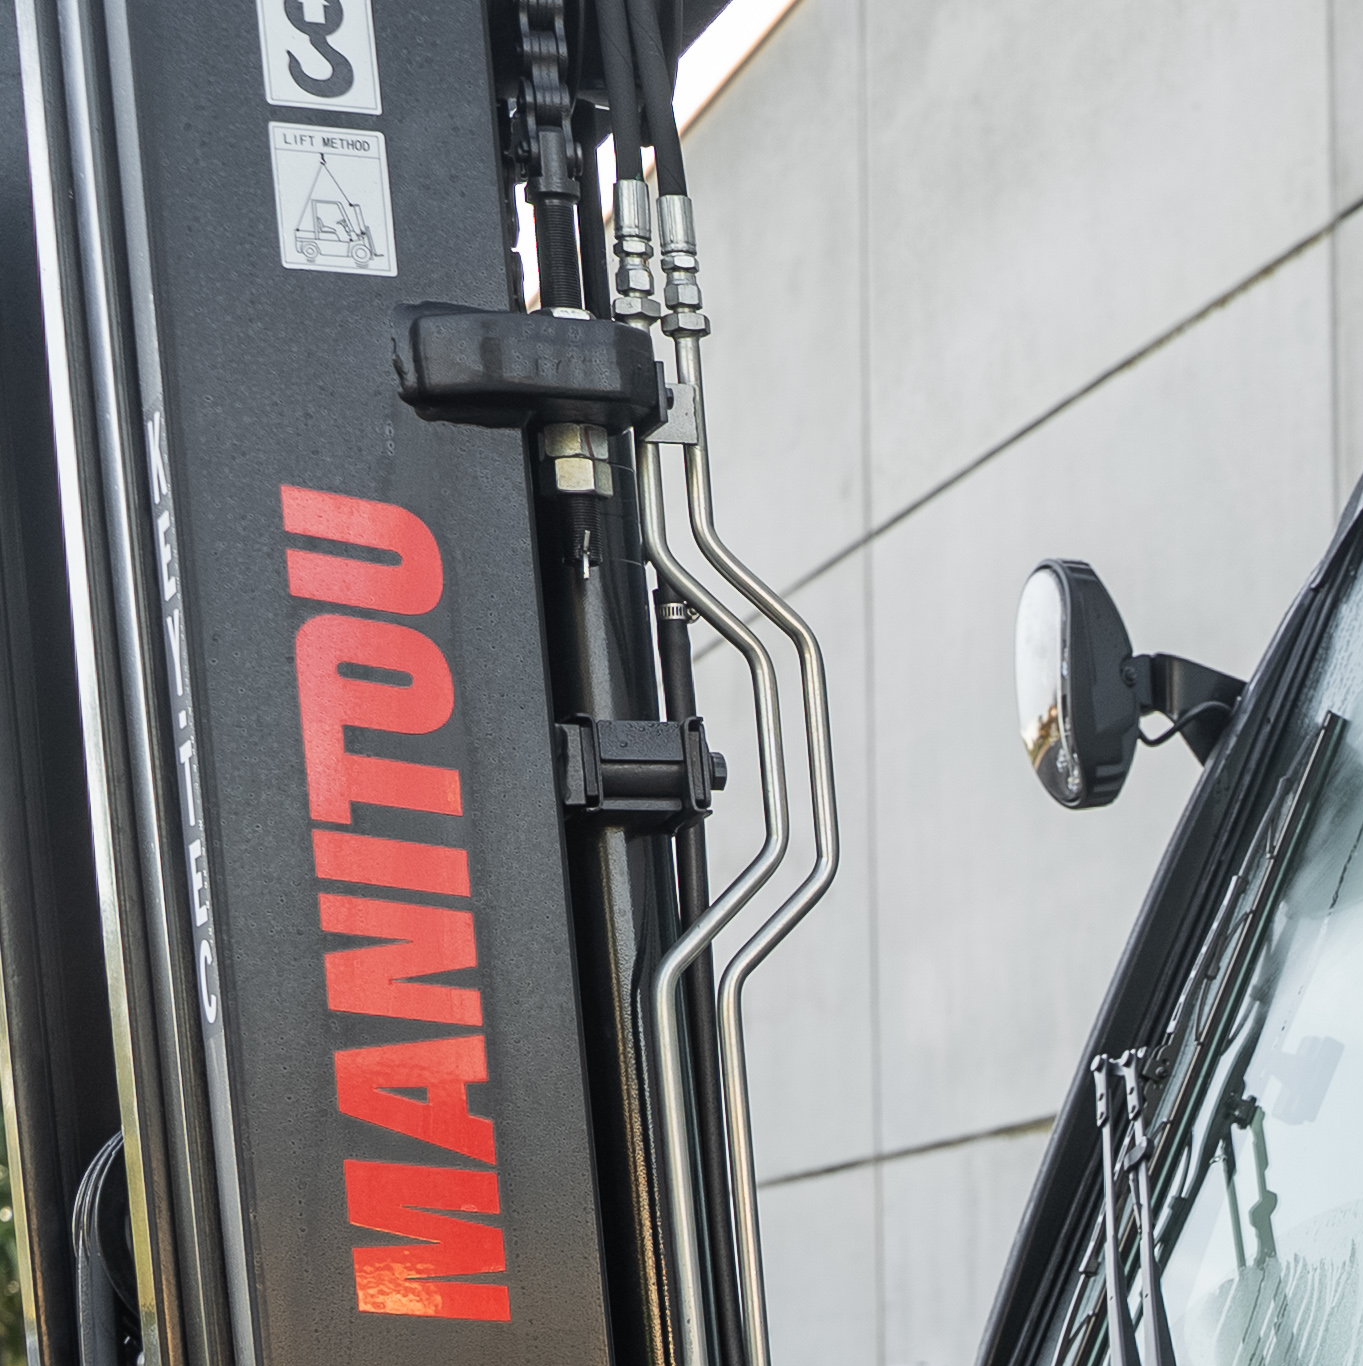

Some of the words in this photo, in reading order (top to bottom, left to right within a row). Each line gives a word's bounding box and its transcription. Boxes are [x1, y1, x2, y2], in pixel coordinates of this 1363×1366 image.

[283, 133, 315, 147] LIFT
[322, 136, 371, 152] METHOD
[280, 485, 511, 1321] MANITOU
